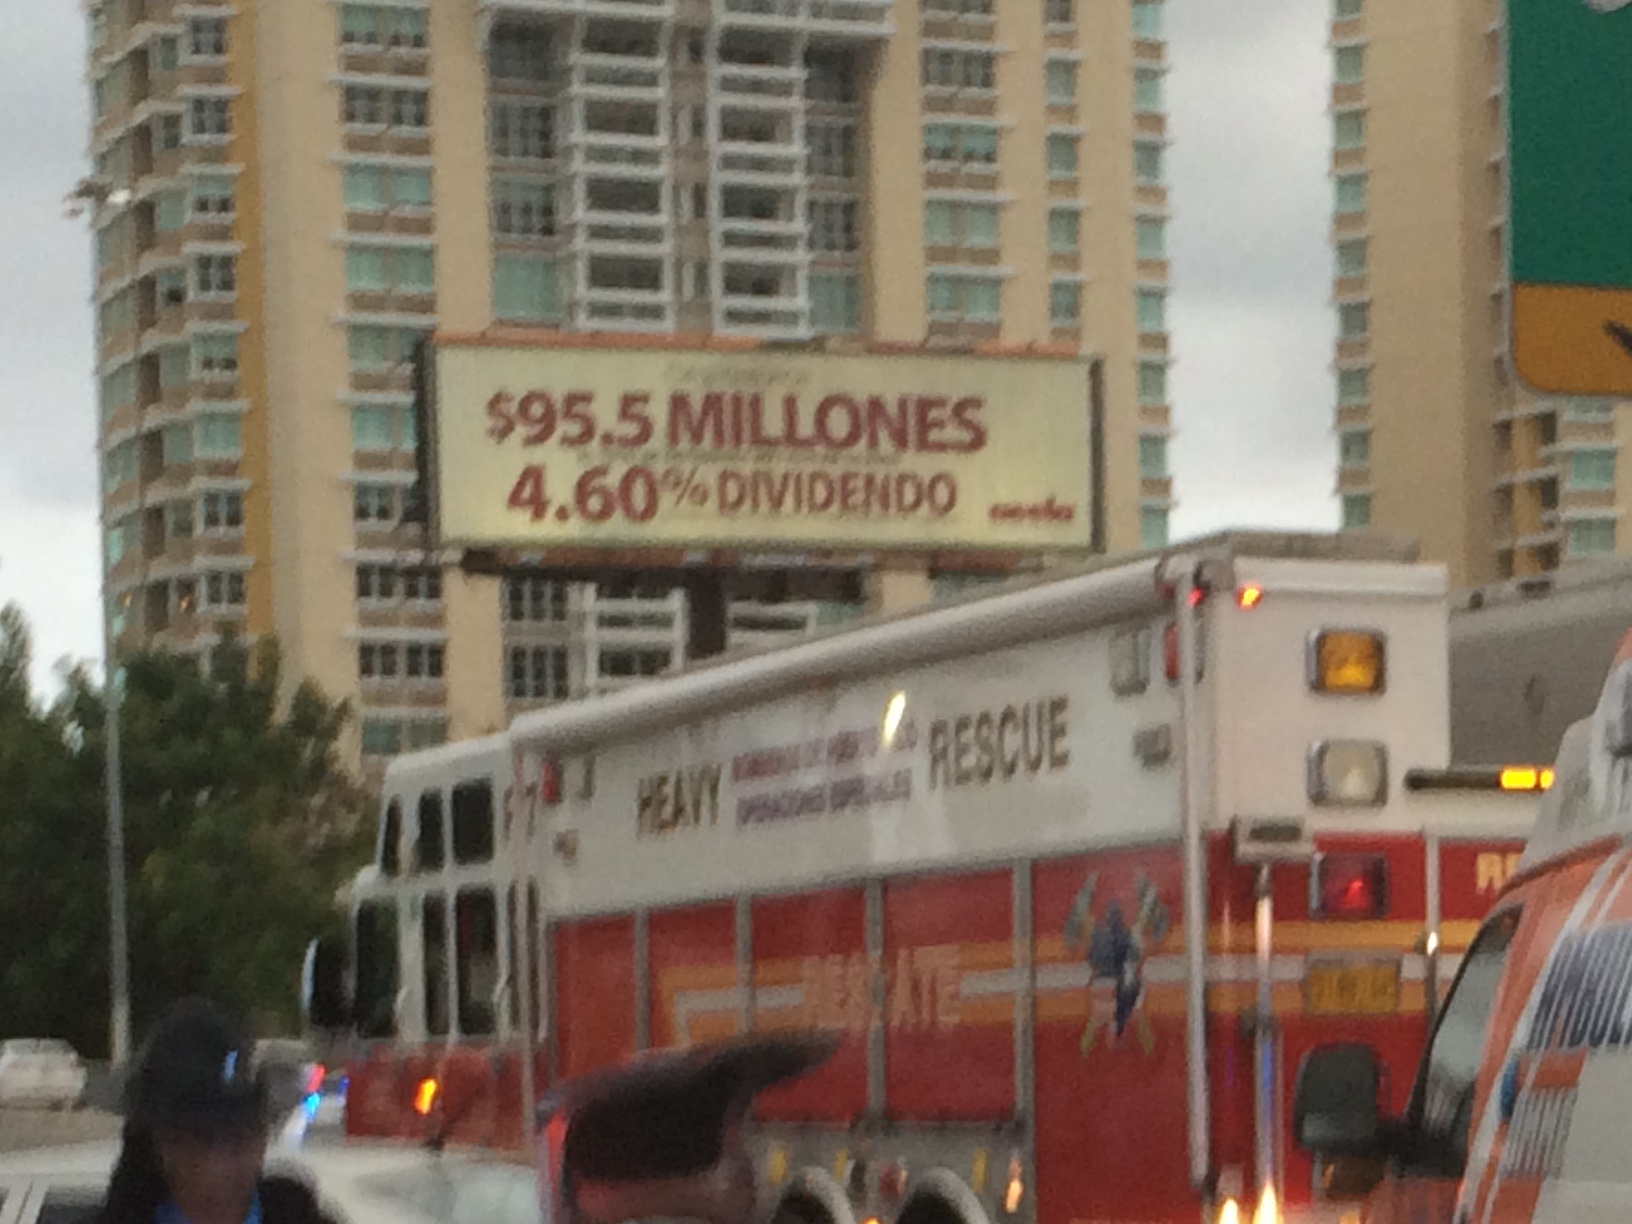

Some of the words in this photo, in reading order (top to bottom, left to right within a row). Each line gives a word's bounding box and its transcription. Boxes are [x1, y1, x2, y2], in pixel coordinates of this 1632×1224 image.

[484, 388, 654, 448] $95.5
[666, 388, 989, 453] MILLONES
[506, 462, 708, 524] 4.60%
[715, 465, 958, 519] DIVIDENDO
[634, 762, 723, 839] HEAVY
[926, 694, 1071, 792] RESCUE
